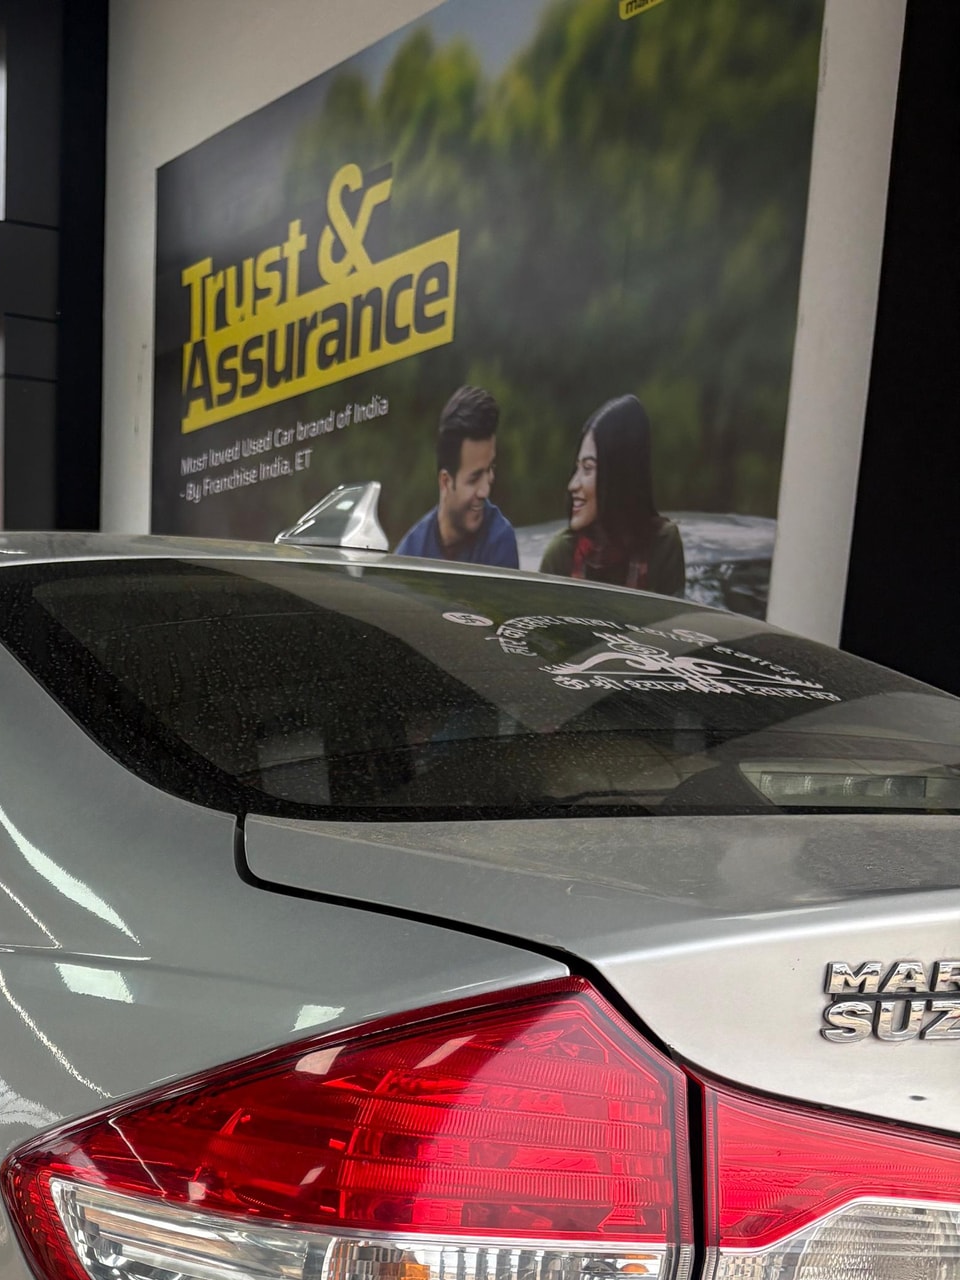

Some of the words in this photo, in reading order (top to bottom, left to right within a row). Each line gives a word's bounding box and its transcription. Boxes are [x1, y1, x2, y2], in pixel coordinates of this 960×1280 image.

[181, 219, 308, 342] Trust
[317, 163, 393, 285] &
[183, 260, 451, 412] Assurance
[181, 453, 208, 476] Most
[241, 430, 272, 458] Used
[274, 428, 295, 448] Car
[296, 410, 335, 442] brand
[336, 404, 353, 429] of
[353, 395, 389, 425] India
[186, 482, 203, 504] By
[203, 468, 259, 497] Franchise
[295, 449, 313, 472] ET
[819, 1000, 960, 1043] SUZ
